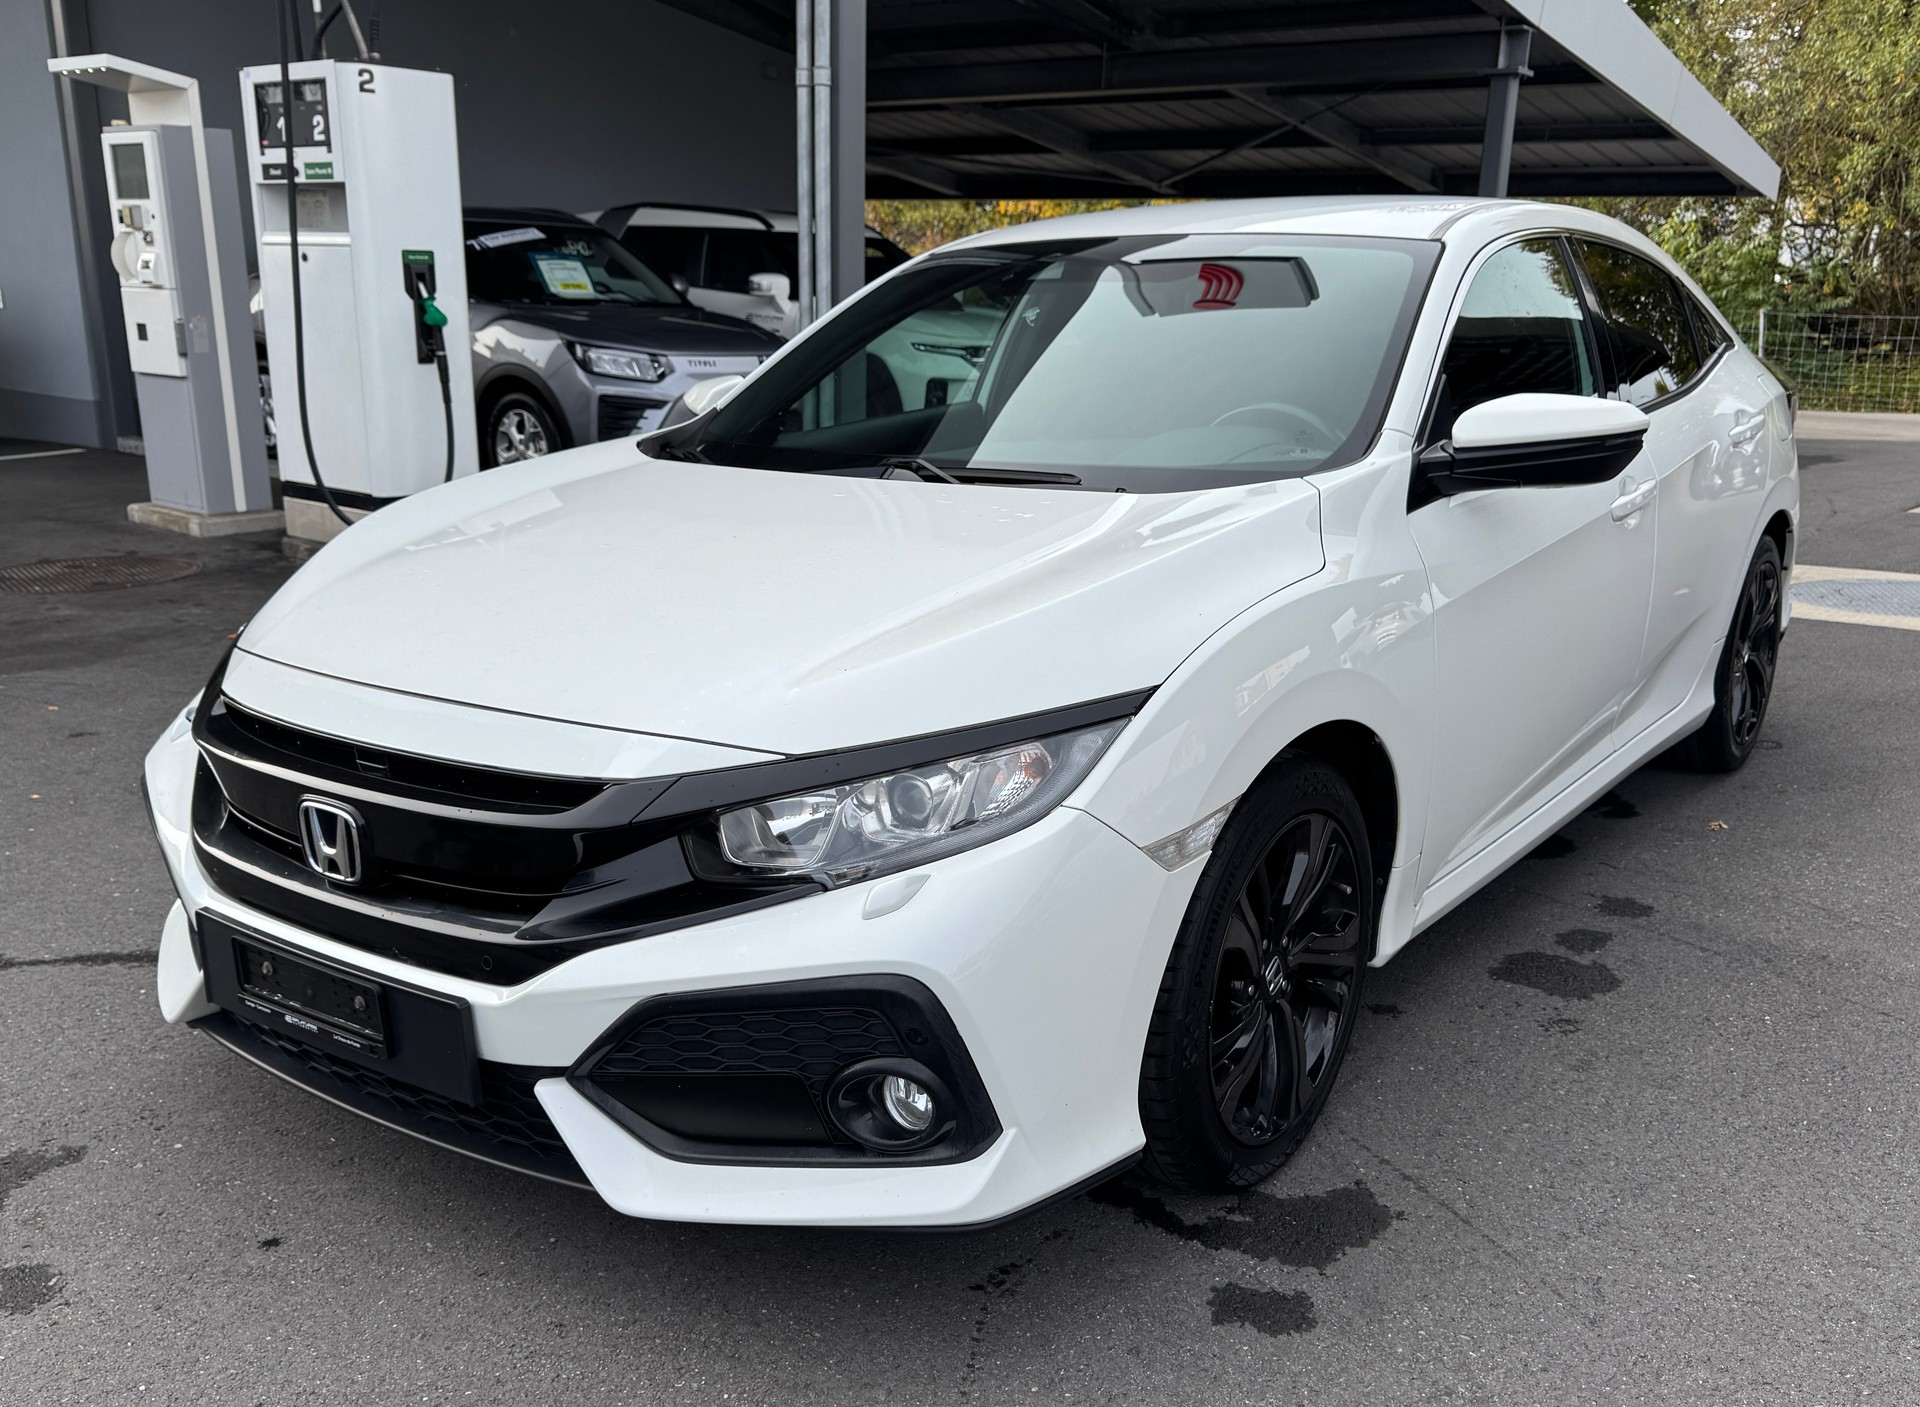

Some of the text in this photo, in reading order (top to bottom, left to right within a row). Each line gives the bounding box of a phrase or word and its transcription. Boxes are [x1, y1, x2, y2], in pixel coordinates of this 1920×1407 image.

[358, 68, 375, 94] 2
[276, 114, 326, 143] 1 2
